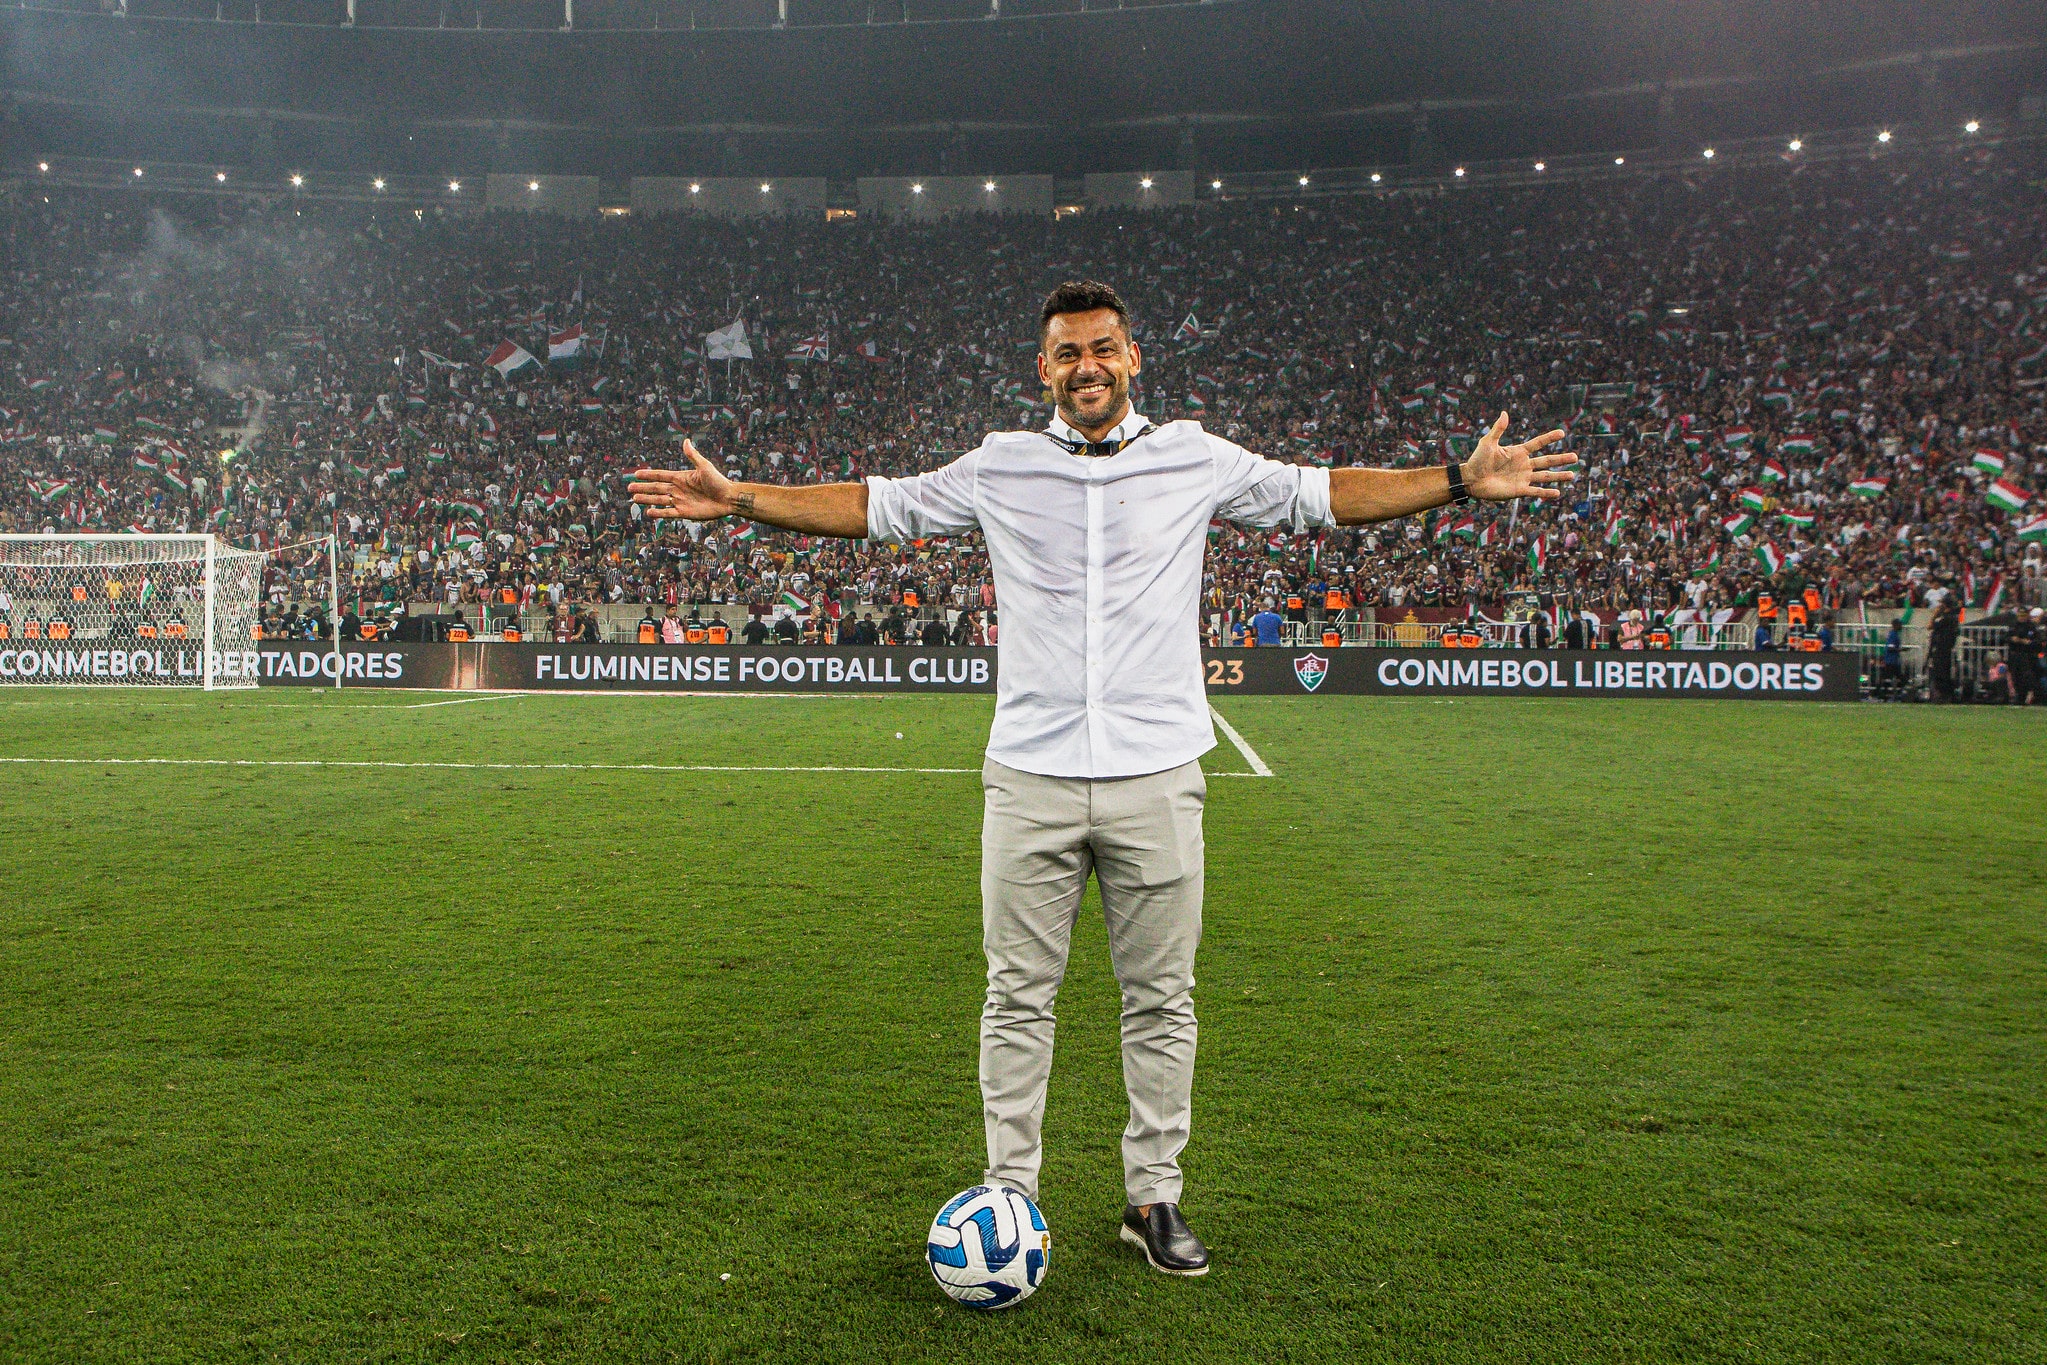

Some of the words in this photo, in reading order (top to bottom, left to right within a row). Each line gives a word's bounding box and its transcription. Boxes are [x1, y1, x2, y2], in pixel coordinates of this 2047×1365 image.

[0, 650, 170, 676] CONMEBOL
[178, 651, 403, 679] LIBERTADORES
[536, 655, 729, 681] FLUMINENSE
[739, 657, 900, 682] FOOTBALL
[908, 658, 989, 683] CLUB
[1201, 659, 1244, 685] 23
[1377, 659, 1568, 687] CONMEBOL
[1575, 661, 1823, 690] LIBERTADORES
